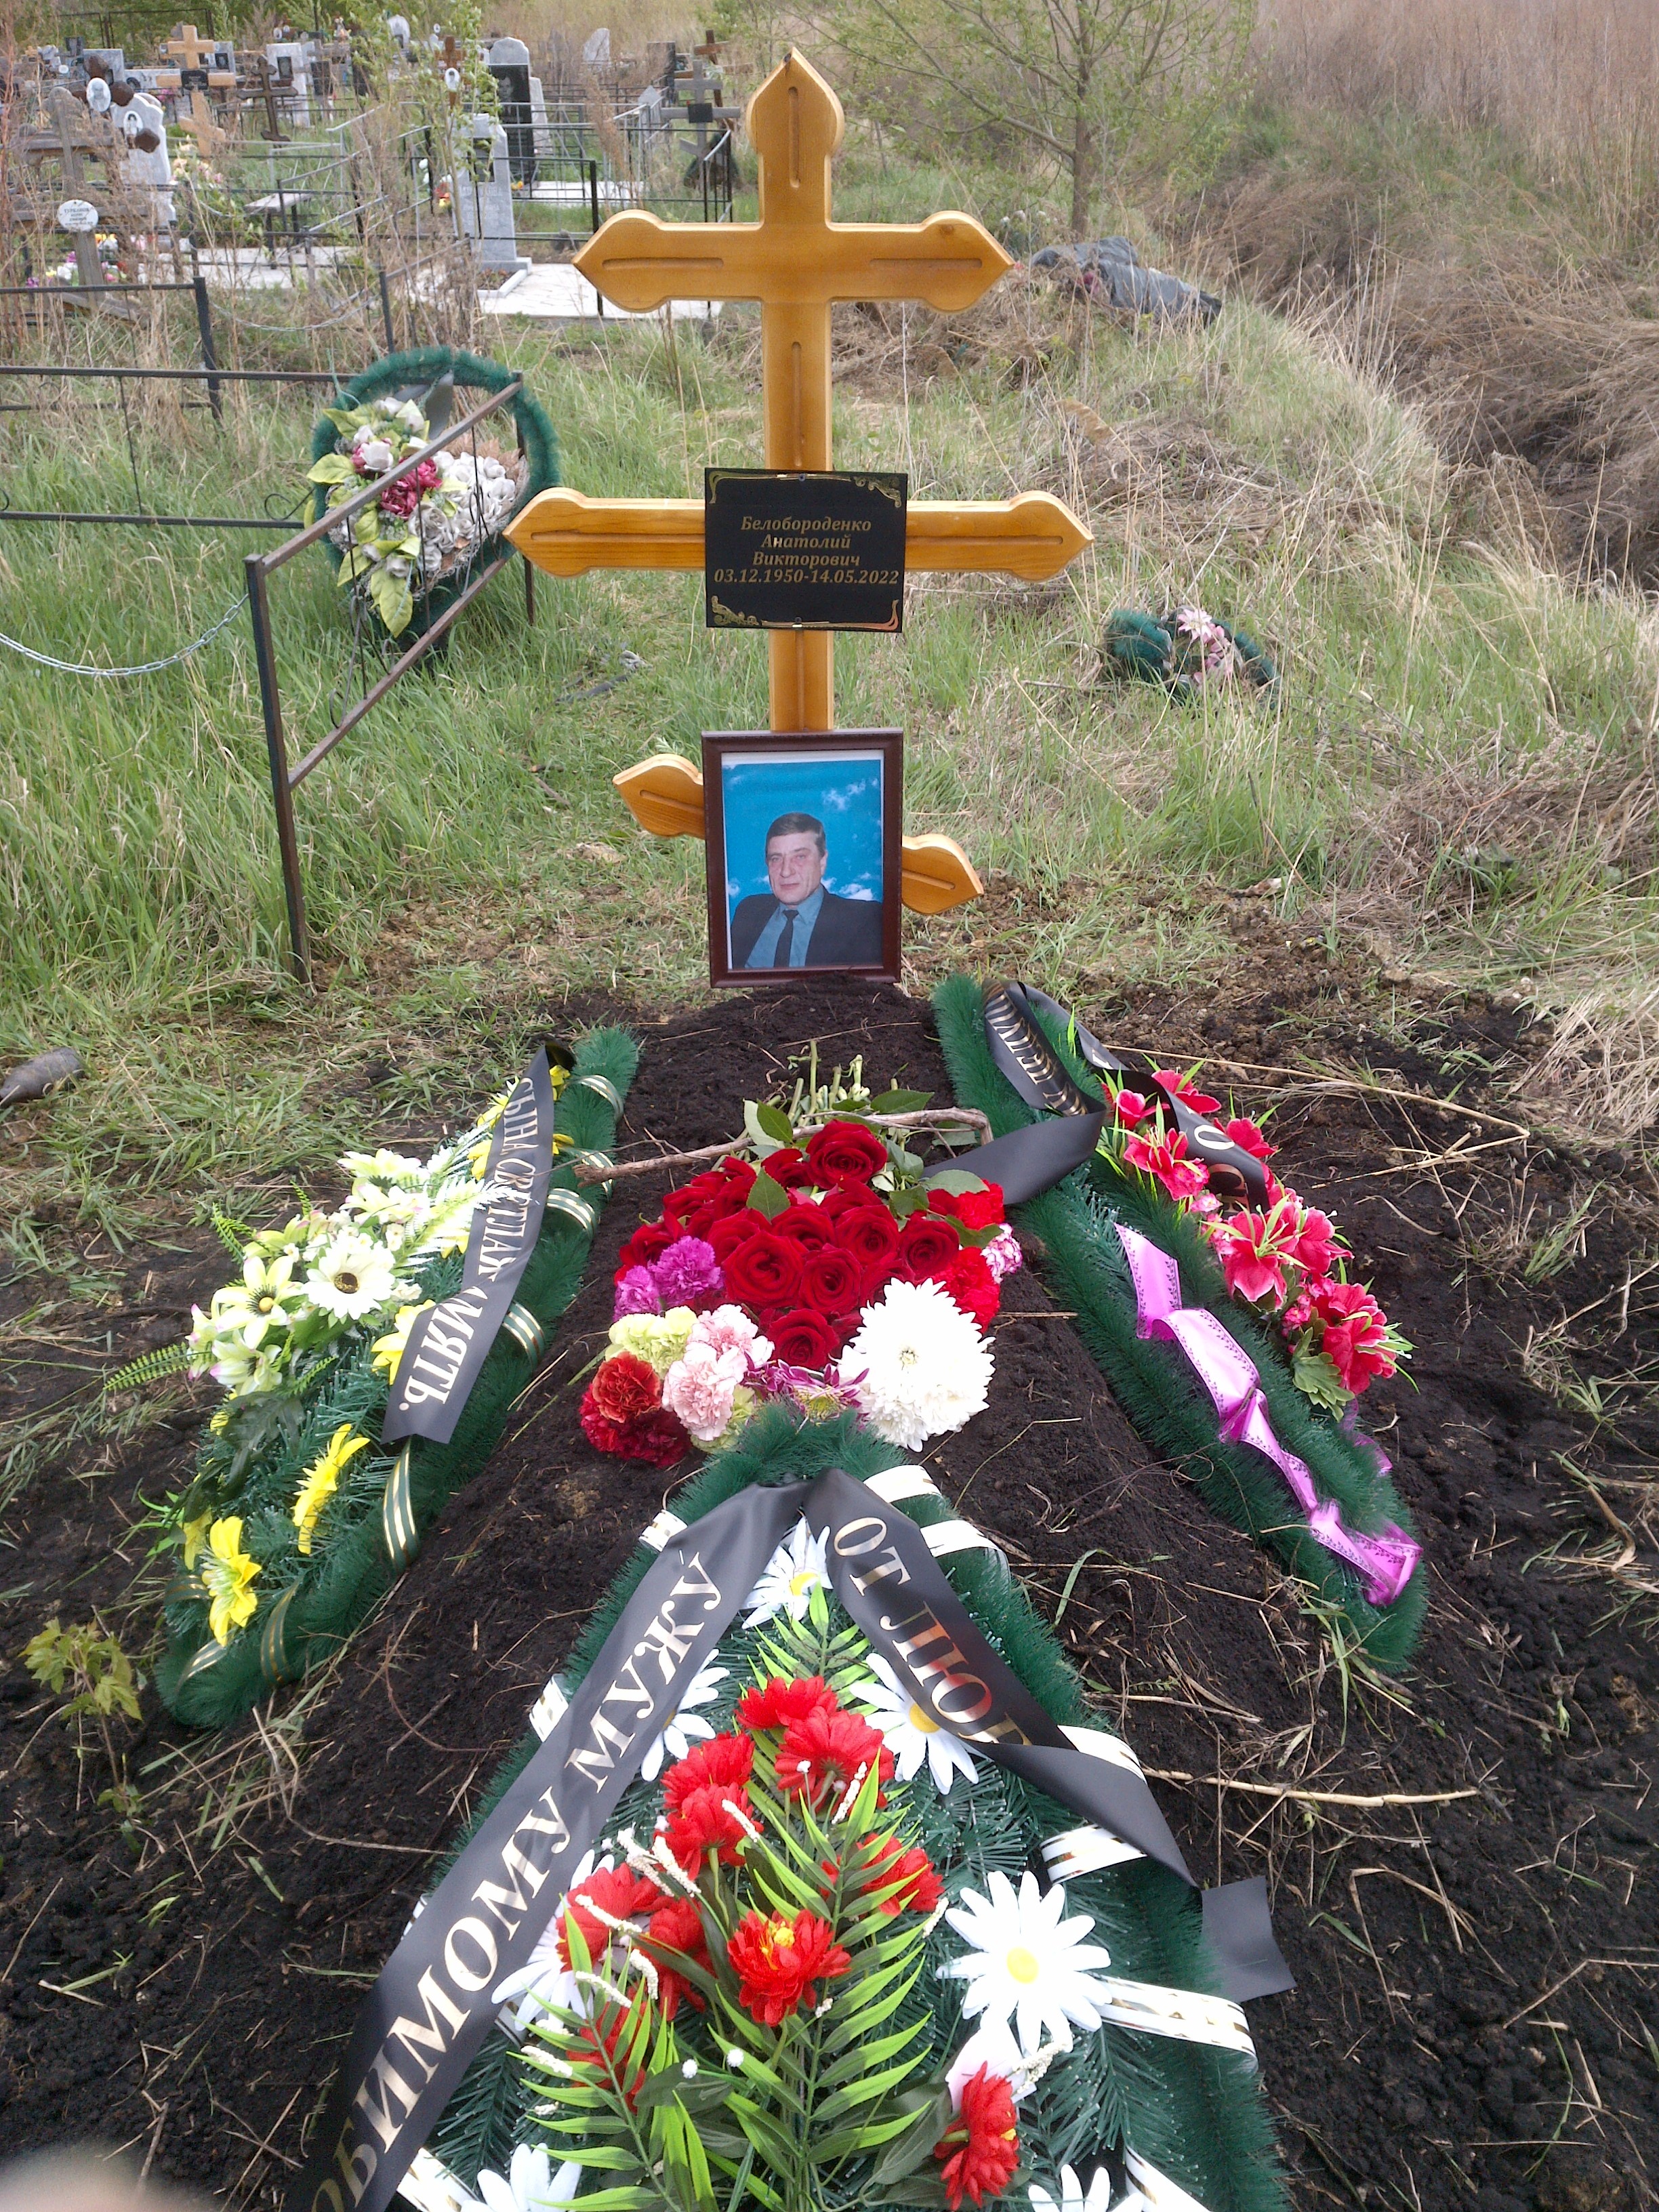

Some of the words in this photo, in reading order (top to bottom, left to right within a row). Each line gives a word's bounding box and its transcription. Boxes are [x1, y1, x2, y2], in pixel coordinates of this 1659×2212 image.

[741, 516, 872, 534] Белобороденко
[761, 533, 851, 549] Анатолий
[753, 551, 860, 569] Викторович
[714, 569, 899, 584] 03.12.1950-14.05.2022
[834, 1517, 911, 1597] ОТ
[564, 1551, 721, 1793] МУЖУ
